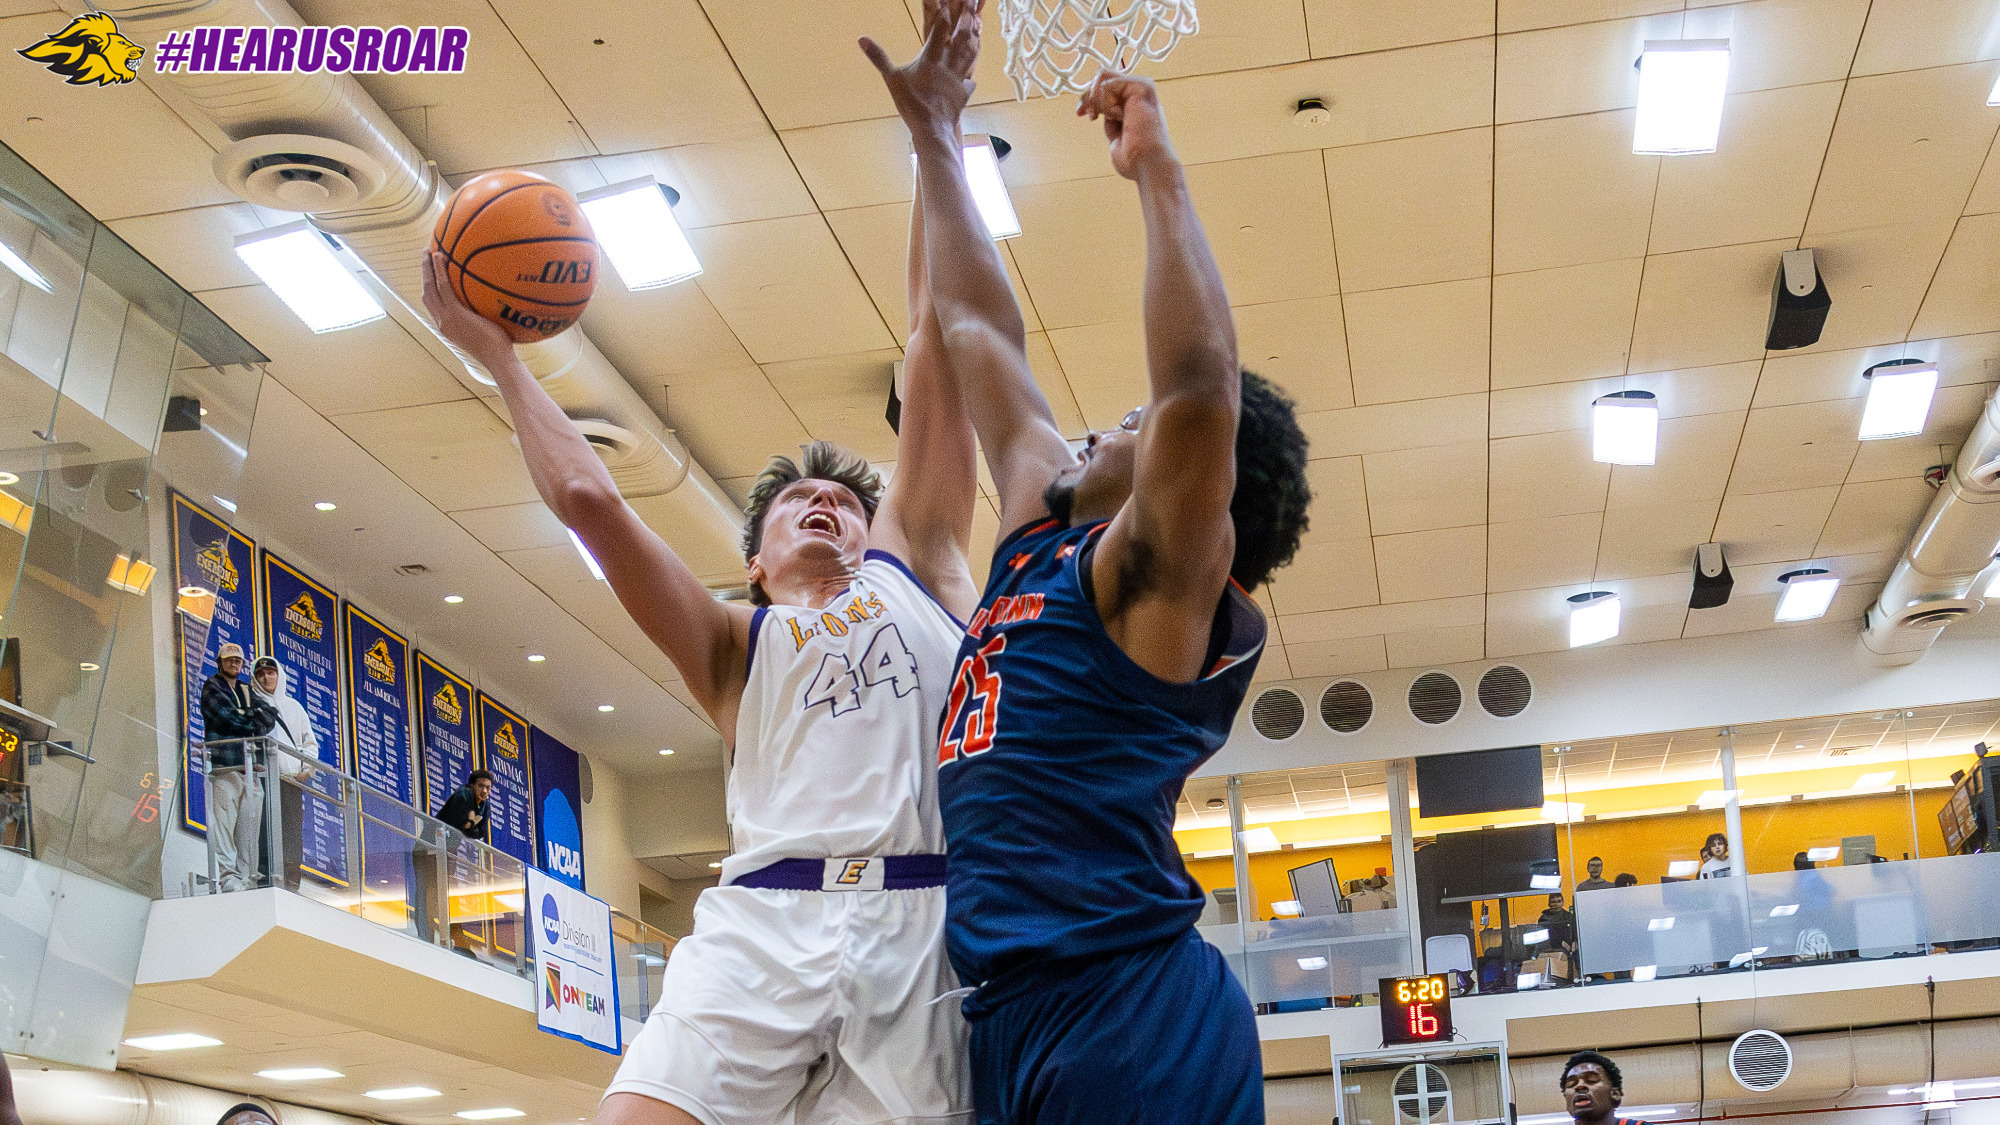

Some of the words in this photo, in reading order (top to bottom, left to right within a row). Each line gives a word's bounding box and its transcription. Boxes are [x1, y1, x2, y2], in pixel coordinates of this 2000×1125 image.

[803, 622, 921, 718] 44
[547, 840, 581, 880] NCAA
[835, 859, 870, 884] E
[544, 916, 560, 934] NCAA
[562, 920, 591, 950] Division
[1398, 979, 1444, 1002] 6:20
[1409, 1003, 1439, 1036] 16
